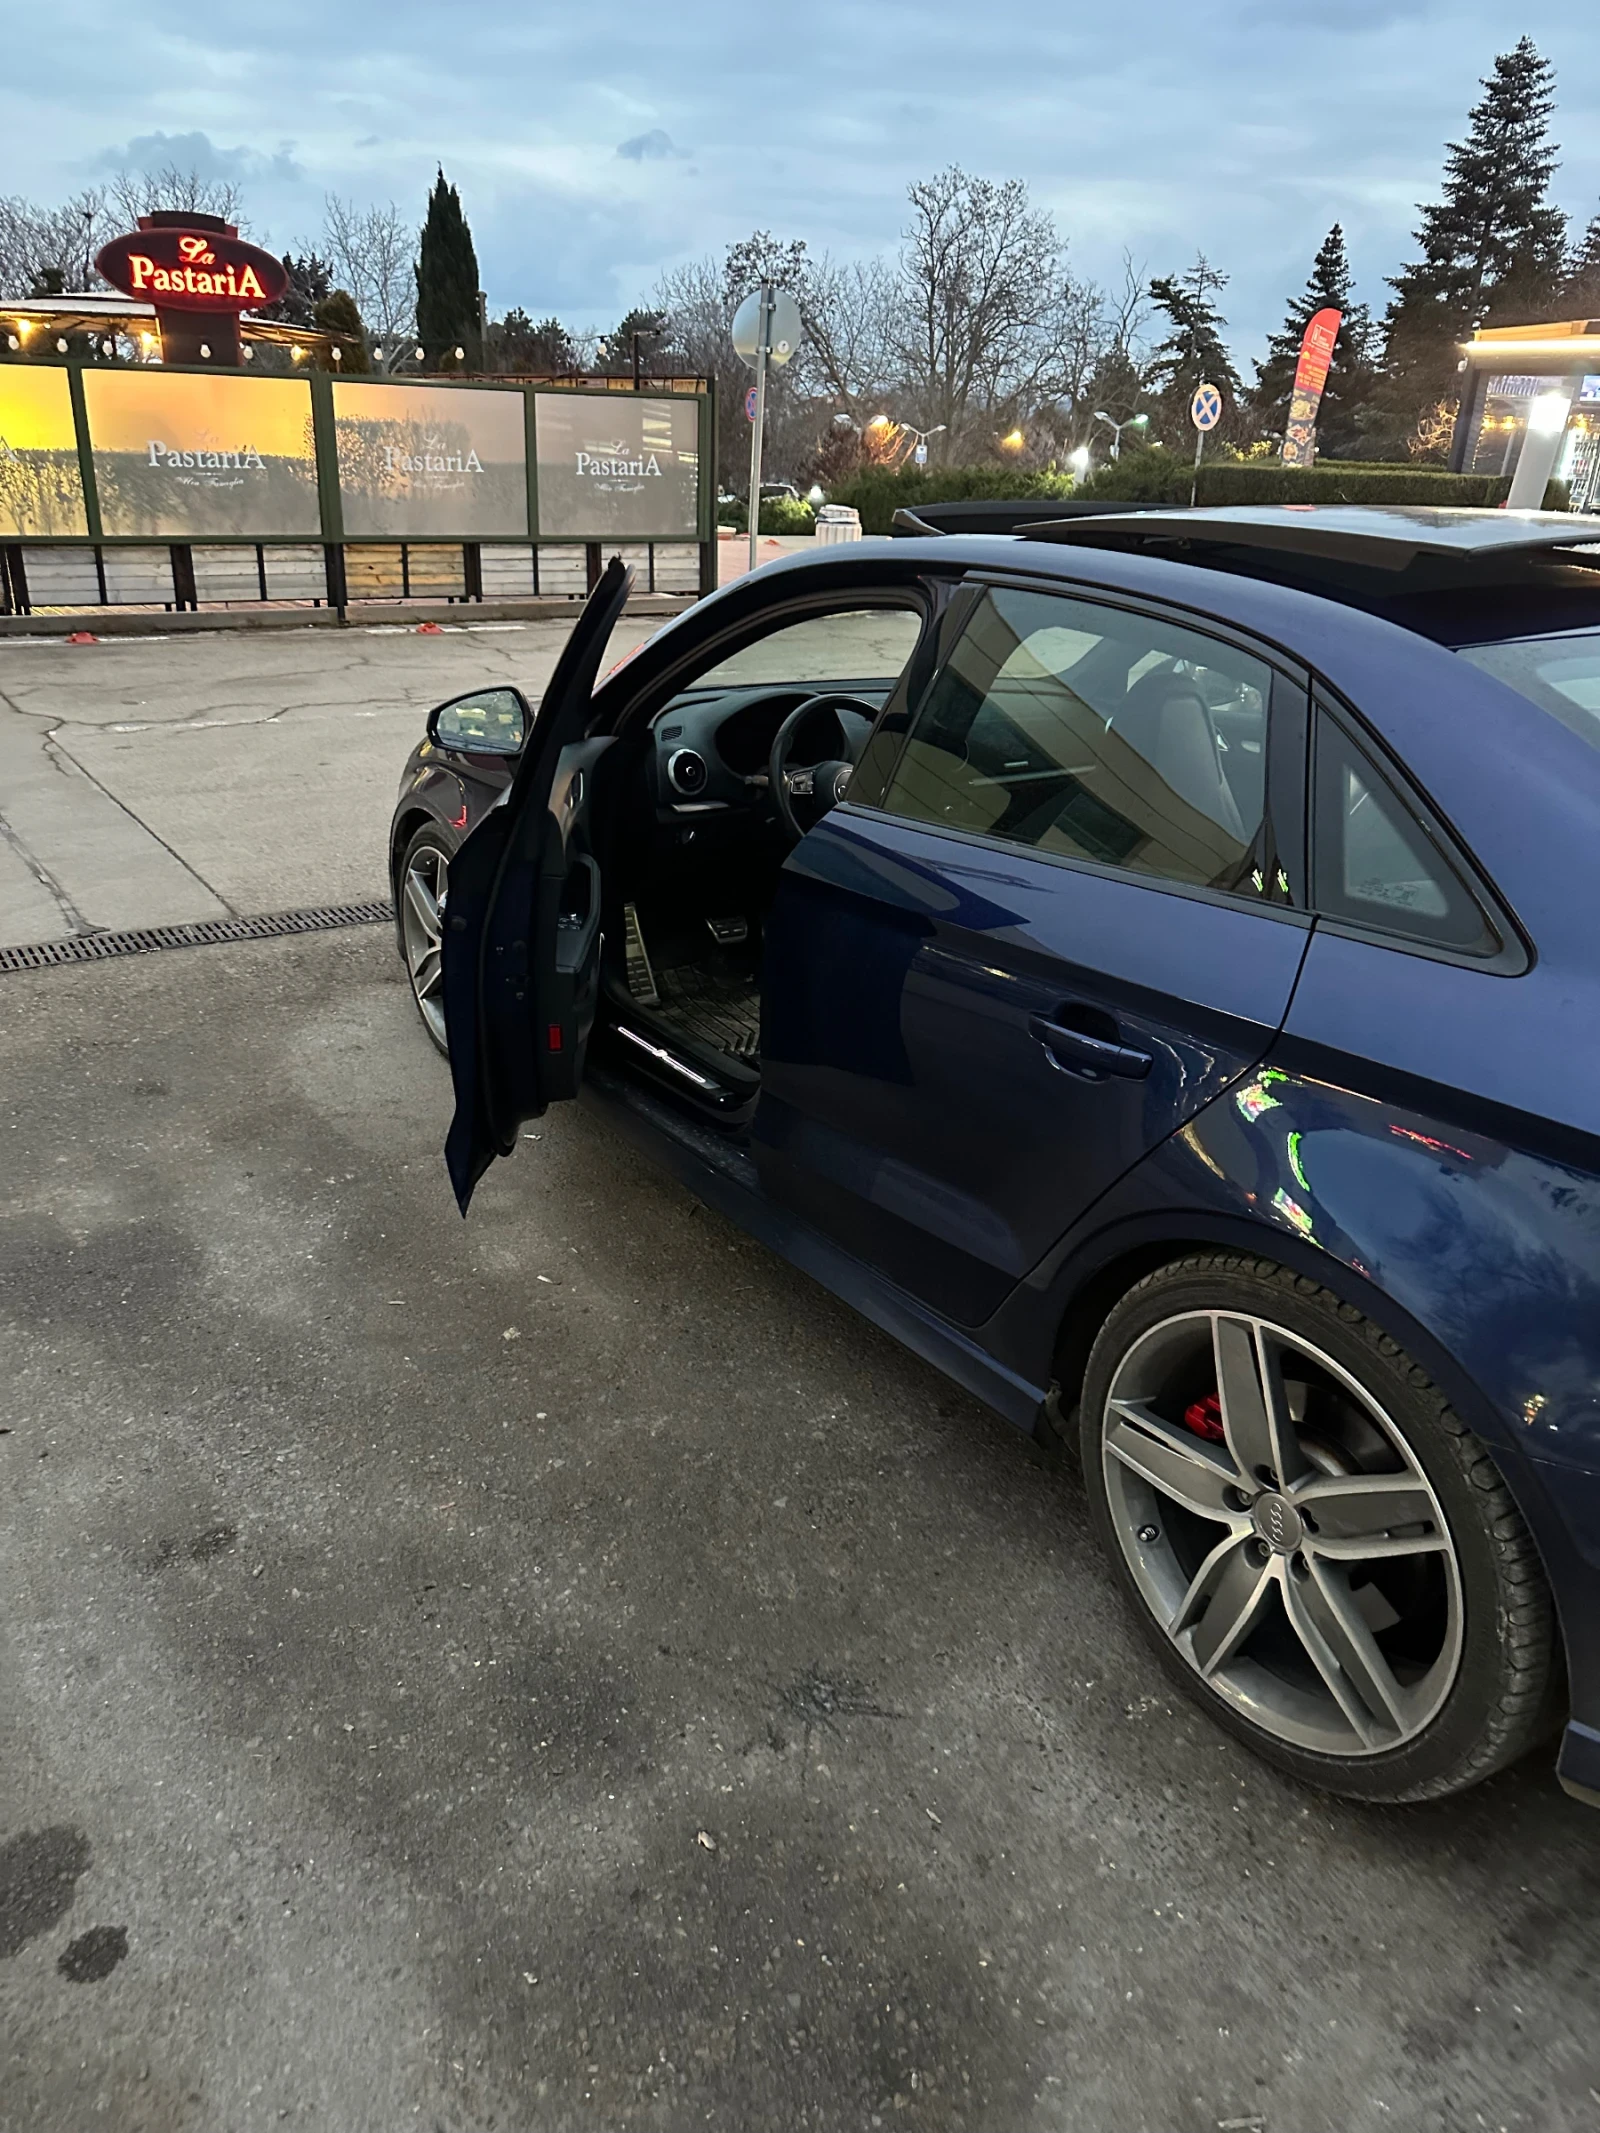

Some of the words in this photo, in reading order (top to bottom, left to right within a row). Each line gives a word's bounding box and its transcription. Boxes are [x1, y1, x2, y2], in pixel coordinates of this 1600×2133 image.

[178, 236, 215, 264] La
[128, 254, 266, 298] PastariA
[146, 439, 267, 470] PastariA
[383, 445, 485, 473] PastariA
[575, 452, 662, 476] PastariA
